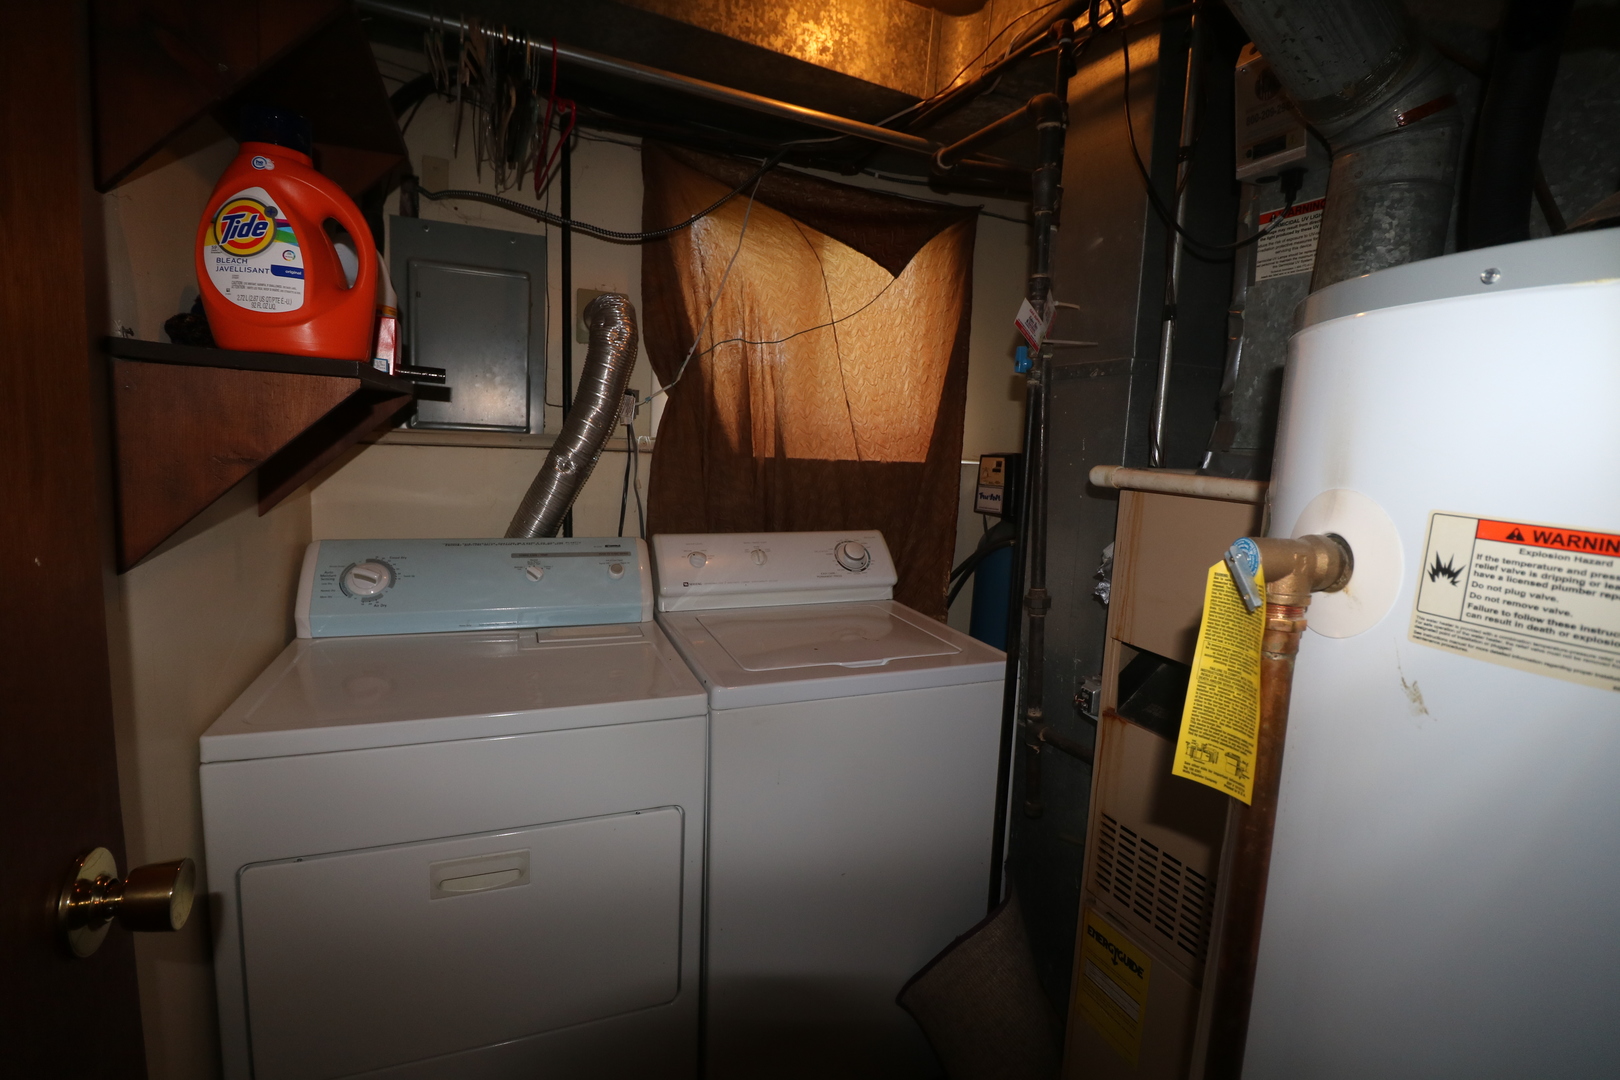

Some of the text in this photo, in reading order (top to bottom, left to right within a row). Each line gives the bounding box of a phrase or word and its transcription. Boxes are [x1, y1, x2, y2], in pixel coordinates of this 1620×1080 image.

[220, 212, 270, 246] Tide
[216, 266, 270, 274] JAVELLISANT
[1534, 530, 1620, 553] WARNIN
[1502, 558, 1563, 572] temperature
[1590, 572, 1620, 581] press
[1519, 548, 1614, 567] Explosion Hazard
[1473, 570, 1495, 579] have
[1506, 575, 1549, 588] licensed
[1551, 584, 1597, 596] plumber
[1475, 563, 1498, 571] relief
[1501, 567, 1526, 576] valve
[1541, 573, 1586, 587] dripping
[1604, 582, 1620, 590] lea
[1469, 592, 1482, 600] Do
[1502, 600, 1539, 610] remove
[1542, 607, 1573, 617] valve.
[1504, 588, 1526, 598] plug
[1529, 592, 1559, 603] valve.
[1467, 602, 1499, 614] Failure
[1514, 612, 1545, 623] follow
[1547, 619, 1577, 629] these
[1580, 624, 1620, 637] instruc
[1485, 616, 1512, 626] result
[1526, 624, 1556, 635] death
[1573, 634, 1620, 647] explosio
